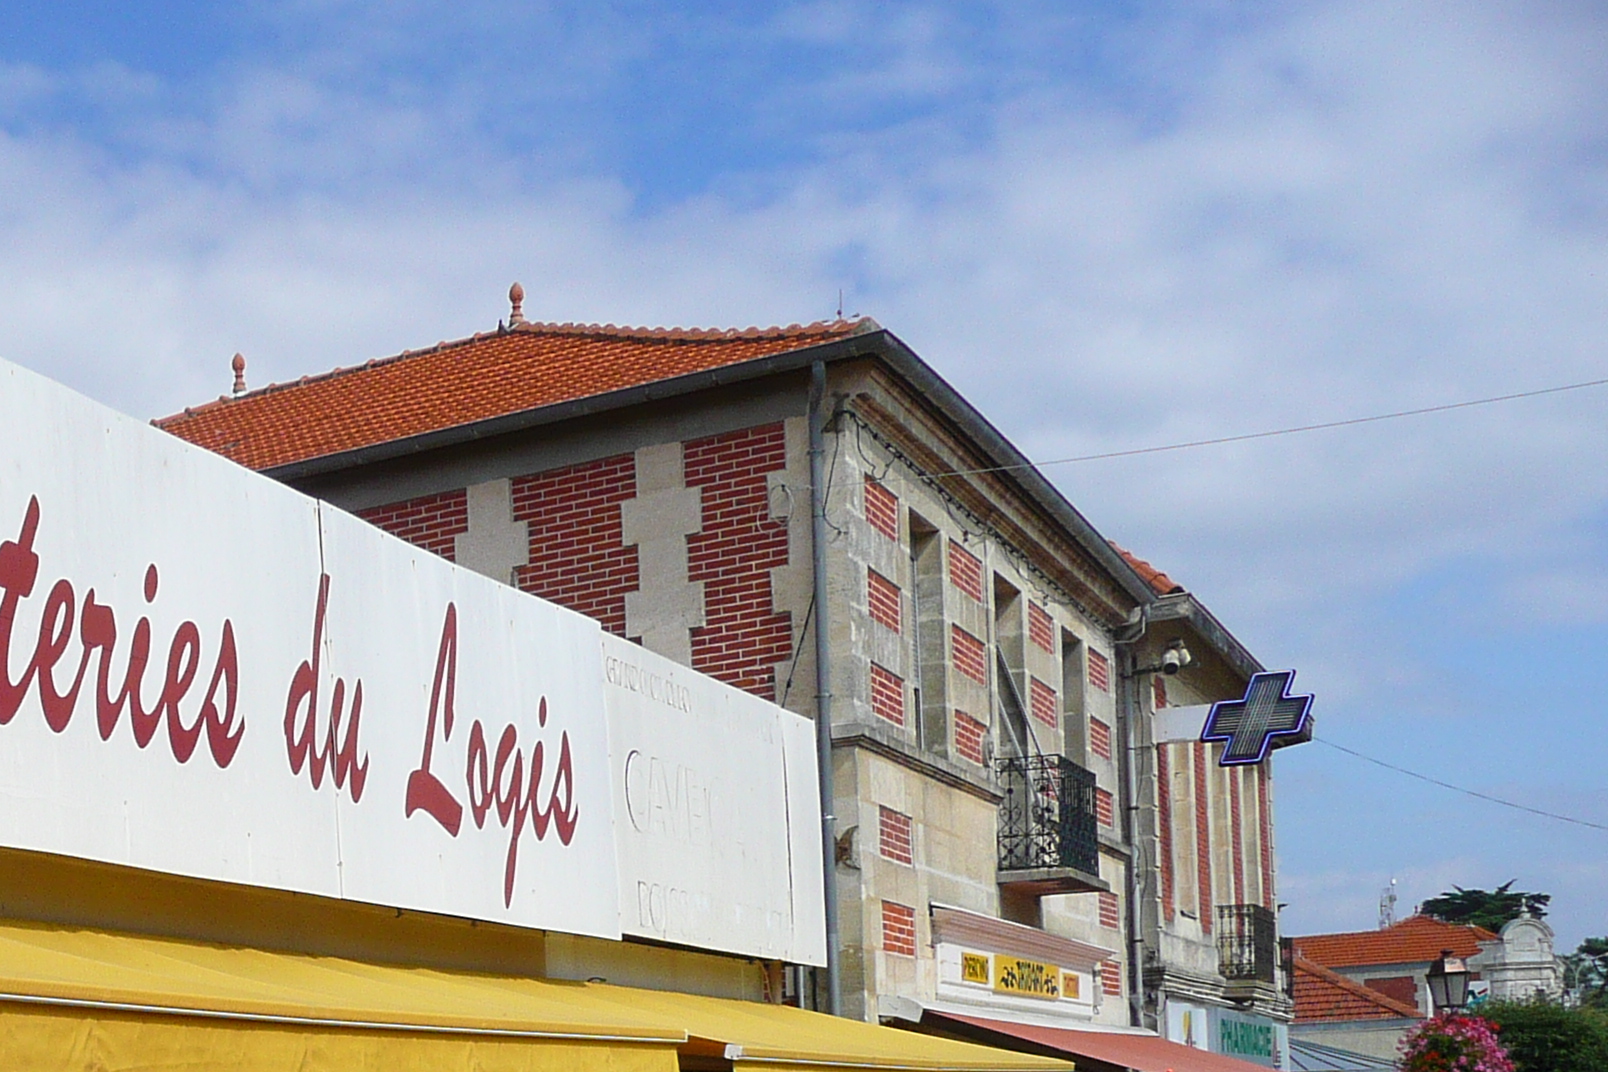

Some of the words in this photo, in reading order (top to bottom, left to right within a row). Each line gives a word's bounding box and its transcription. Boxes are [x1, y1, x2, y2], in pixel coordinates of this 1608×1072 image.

[284, 572, 369, 803] du
[404, 601, 579, 909] Logis
[1220, 1018, 1272, 1058] PHARMACIE
